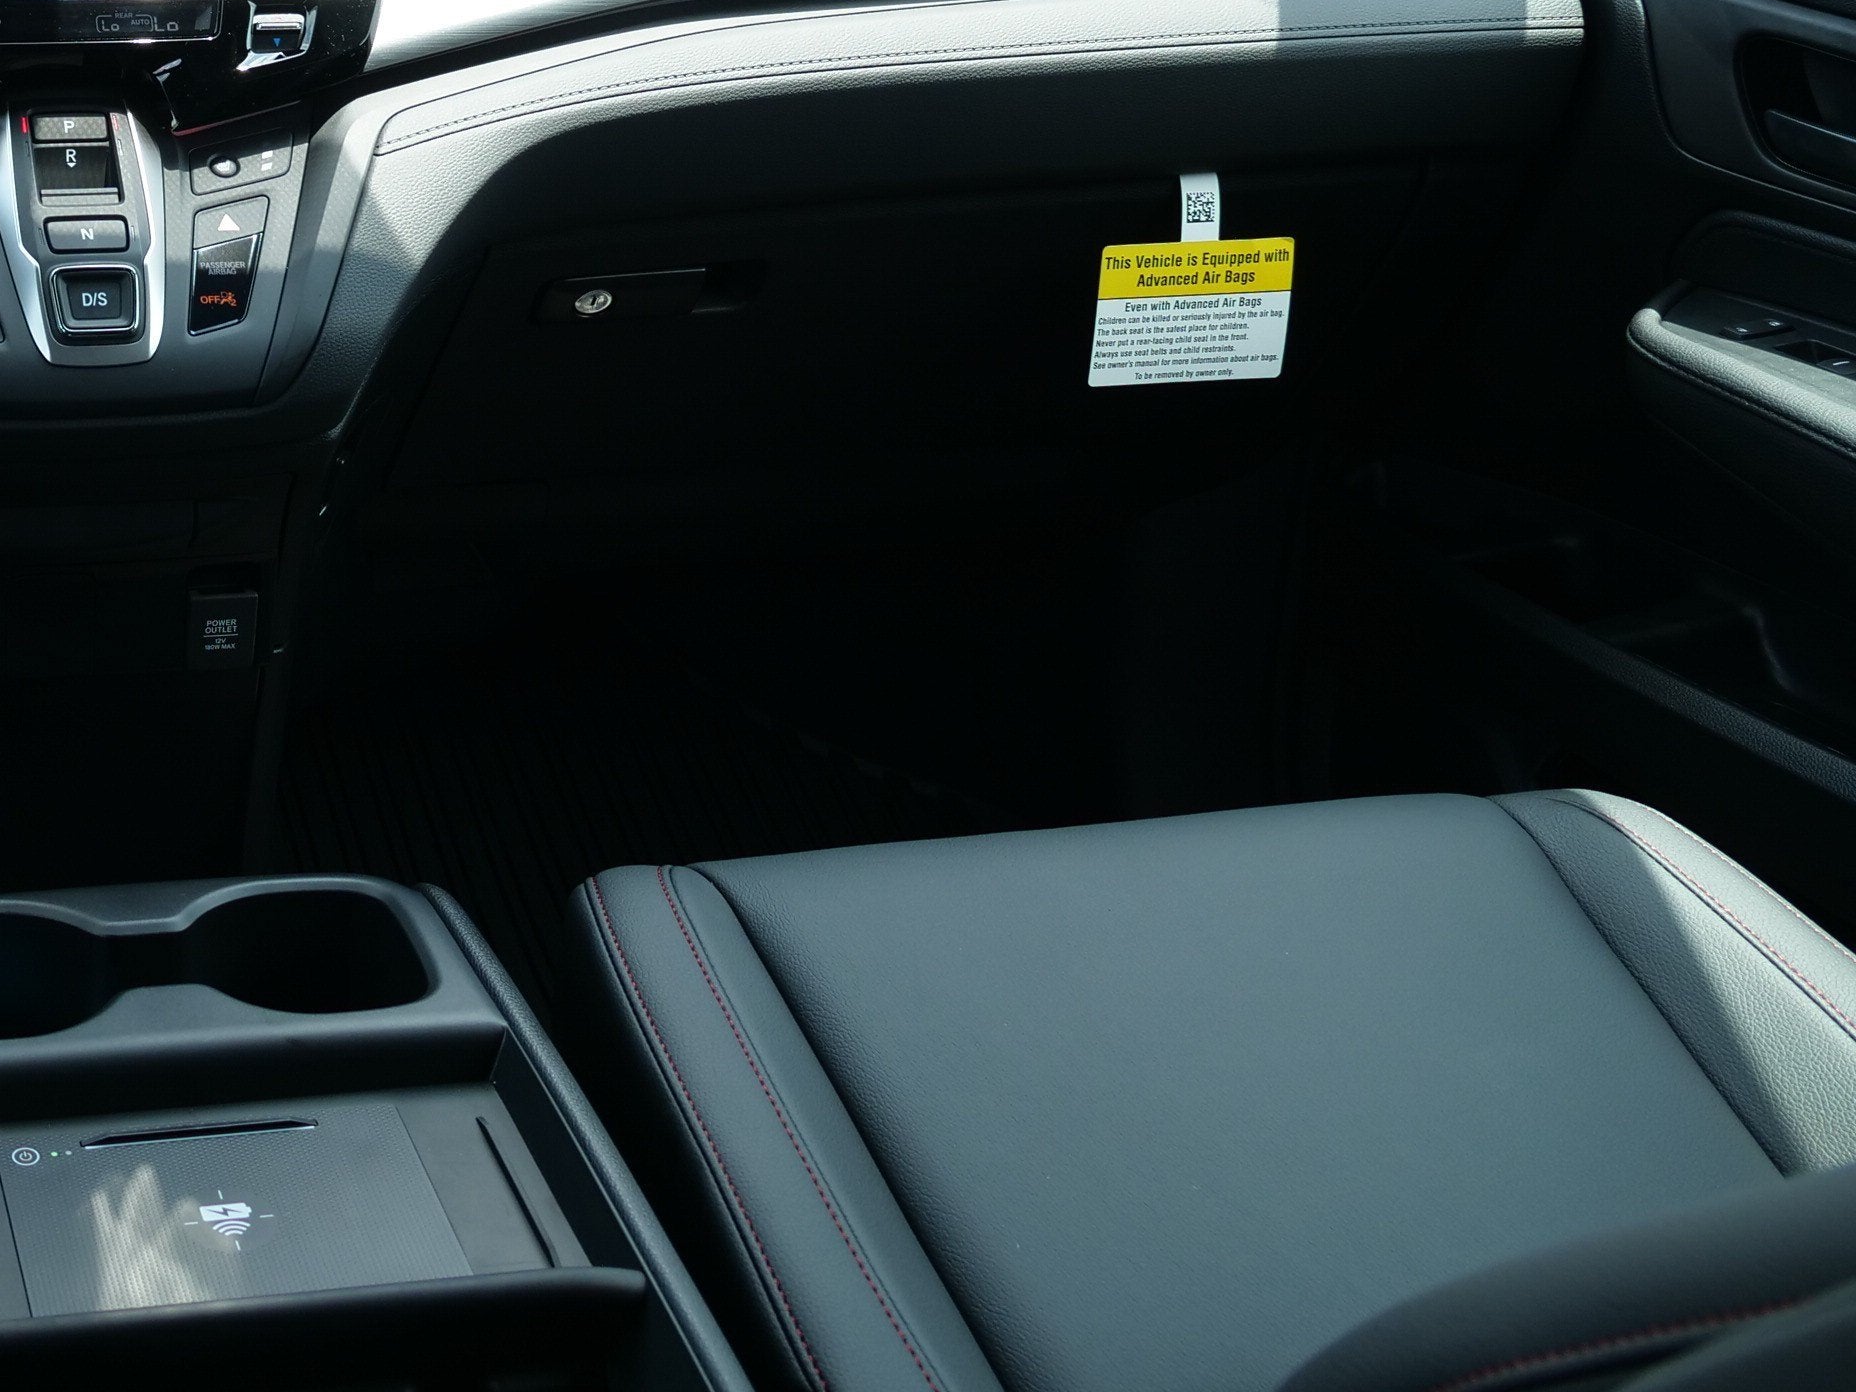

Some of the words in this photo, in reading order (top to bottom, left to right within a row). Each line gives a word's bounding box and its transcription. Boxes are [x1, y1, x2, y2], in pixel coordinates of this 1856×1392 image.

[63, 120, 75, 133] P
[65, 149, 77, 162] R
[80, 228, 94, 240] N
[200, 261, 246, 269] PASSENGER
[1105, 256, 1131, 270] This
[1136, 254, 1183, 269] Vehicle
[1187, 254, 1198, 267] is
[1202, 250, 1260, 267] Equipped
[1264, 248, 1290, 263] with
[1136, 272, 1198, 288] Advanced
[1202, 270, 1221, 285] Air
[1225, 270, 1256, 285] Bags
[81, 291, 108, 307] D/S
[200, 295, 221, 304] OFF
[1124, 301, 1148, 313] Even
[1150, 300, 1171, 311] with
[1173, 298, 1219, 310] Advanced
[1222, 297, 1236, 308] Air
[1239, 296, 1262, 308] Bags
[1098, 316, 1127, 326] Children
[1128, 316, 1140, 324] can
[1141, 315, 1151, 323] be
[1152, 314, 1171, 323] killed
[1180, 313, 1211, 322] seriously
[1212, 311, 1237, 321] injured
[1237, 311, 1246, 320] by
[1247, 310, 1258, 318] the
[1259, 310, 1269, 318] air
[1270, 309, 1285, 318] bag.
[1097, 328, 1111, 336] The
[1111, 328, 1127, 336] back
[1129, 327, 1144, 335] seat
[1153, 326, 1164, 334] the
[1166, 325, 1187, 333] safest
[1187, 324, 1207, 333] place
[1208, 323, 1219, 331] for
[1219, 322, 1250, 330] children.
[1095, 339, 1116, 348] Never
[1117, 339, 1129, 348] put
[1136, 337, 1173, 346] rear-facing
[1175, 335, 1192, 344] child
[1193, 335, 1208, 343] seat
[1218, 333, 1229, 342] the
[1230, 333, 1249, 341] front.
[1094, 351, 1119, 360] Always
[1120, 350, 1133, 358] use
[1134, 349, 1149, 357] seat
[1150, 348, 1168, 356] belts
[1168, 347, 1181, 355] and
[1183, 346, 1200, 354] child
[1201, 345, 1236, 354] restraints.
[1093, 362, 1106, 370] See
[1107, 360, 1133, 369] owner's
[1134, 359, 1160, 368] manual
[1160, 358, 1171, 366] for
[1171, 357, 1189, 365] more
[1190, 356, 1229, 365] information
[1230, 355, 1249, 363] about
[1250, 354, 1260, 362] air
[1260, 353, 1279, 363] bags.
[1134, 372, 1142, 380] To
[1143, 372, 1153, 380] be
[1154, 371, 1184, 379] removed
[1185, 370, 1194, 379] by
[1195, 369, 1216, 377] owner
[1217, 368, 1234, 377] only.
[204, 625, 238, 634] OUTLET
[206, 618, 237, 627] POWER
